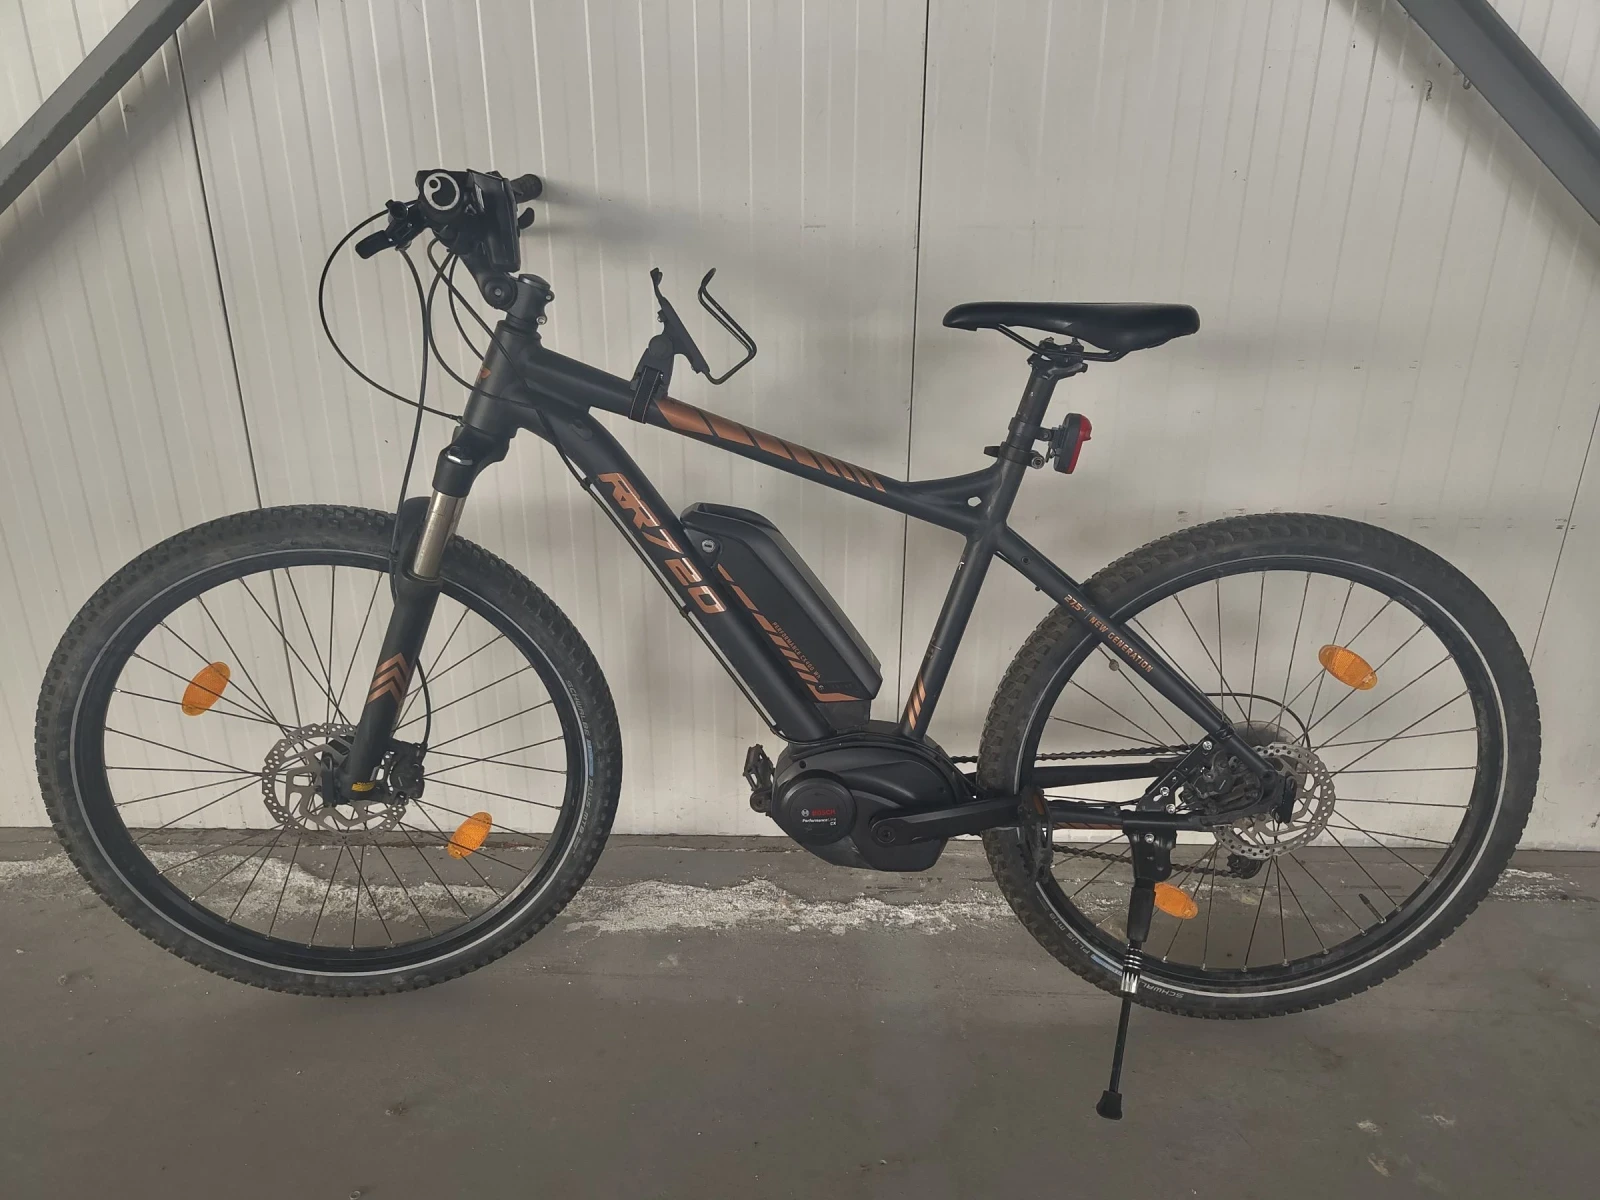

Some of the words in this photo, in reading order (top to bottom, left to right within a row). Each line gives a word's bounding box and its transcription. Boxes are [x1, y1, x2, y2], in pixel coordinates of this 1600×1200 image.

[772, 621, 802, 656] PERFORMANCE
[1089, 616, 1109, 633] NEW
[1107, 632, 1154, 673] GENERATION
[566, 680, 590, 736] SCHWALBE
[586, 779, 594, 808] PLUS
[580, 812, 588, 834] MTB
[1049, 912, 1066, 931] MTB
[1066, 932, 1090, 954] PLUS
[1141, 981, 1185, 999] SCHWAL
